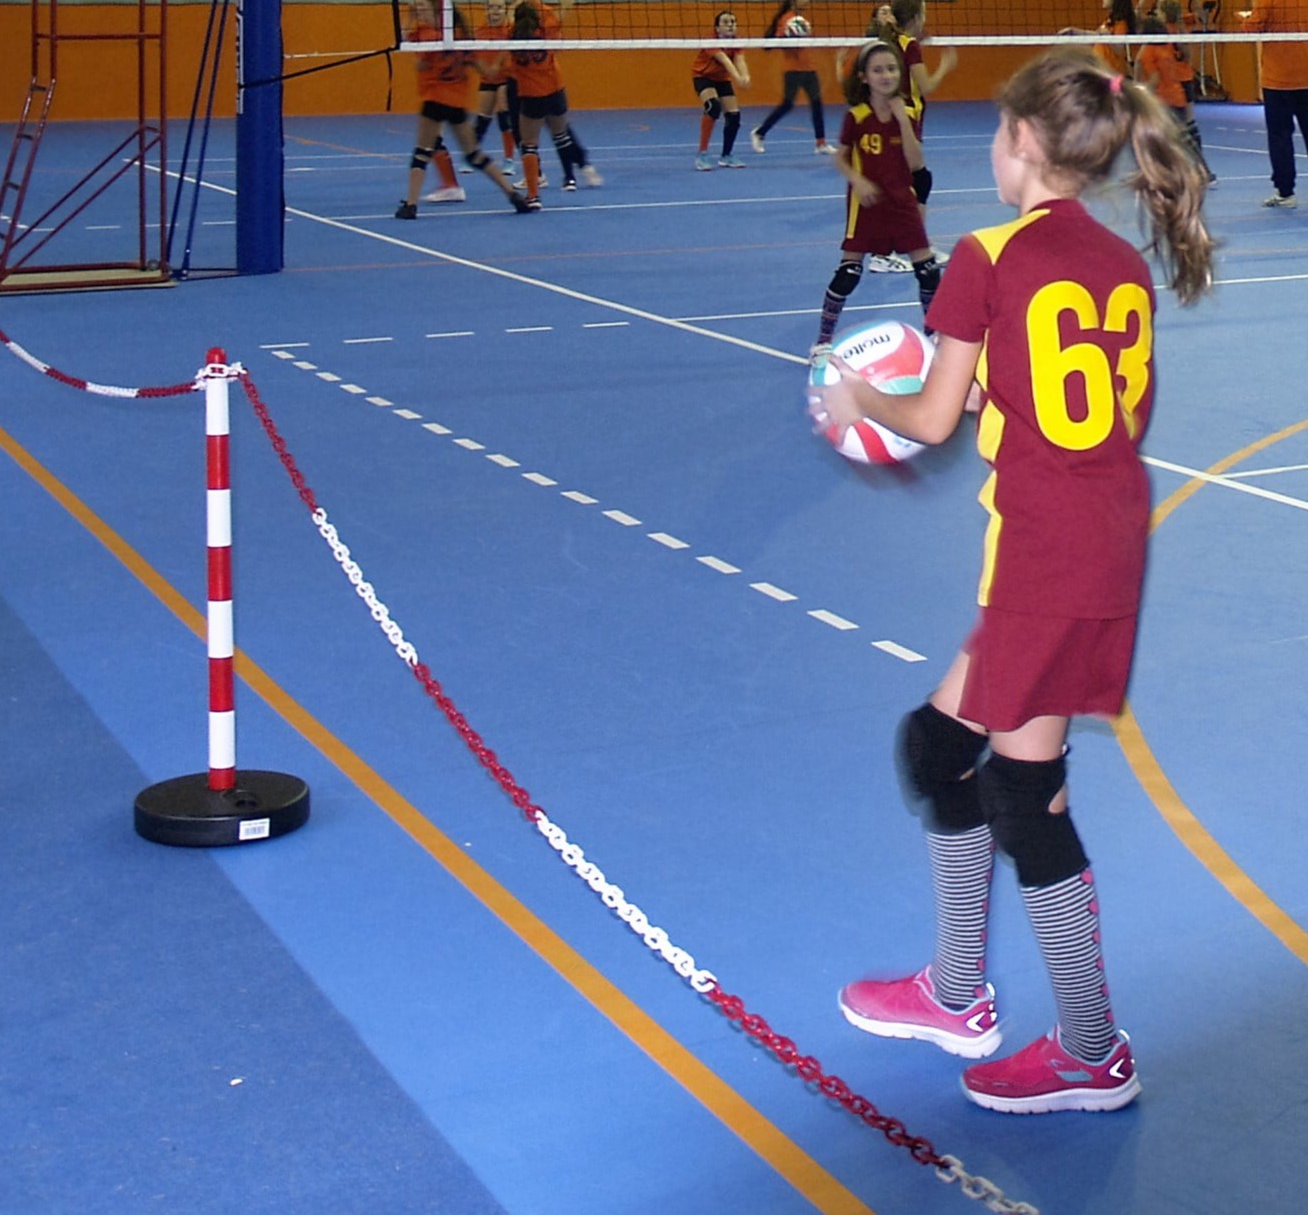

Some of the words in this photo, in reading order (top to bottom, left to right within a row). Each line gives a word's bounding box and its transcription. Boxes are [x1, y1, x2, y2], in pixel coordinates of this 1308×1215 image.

[860, 133, 882, 154] 49
[843, 333, 892, 360] molte
[1026, 280, 1154, 451] 63
